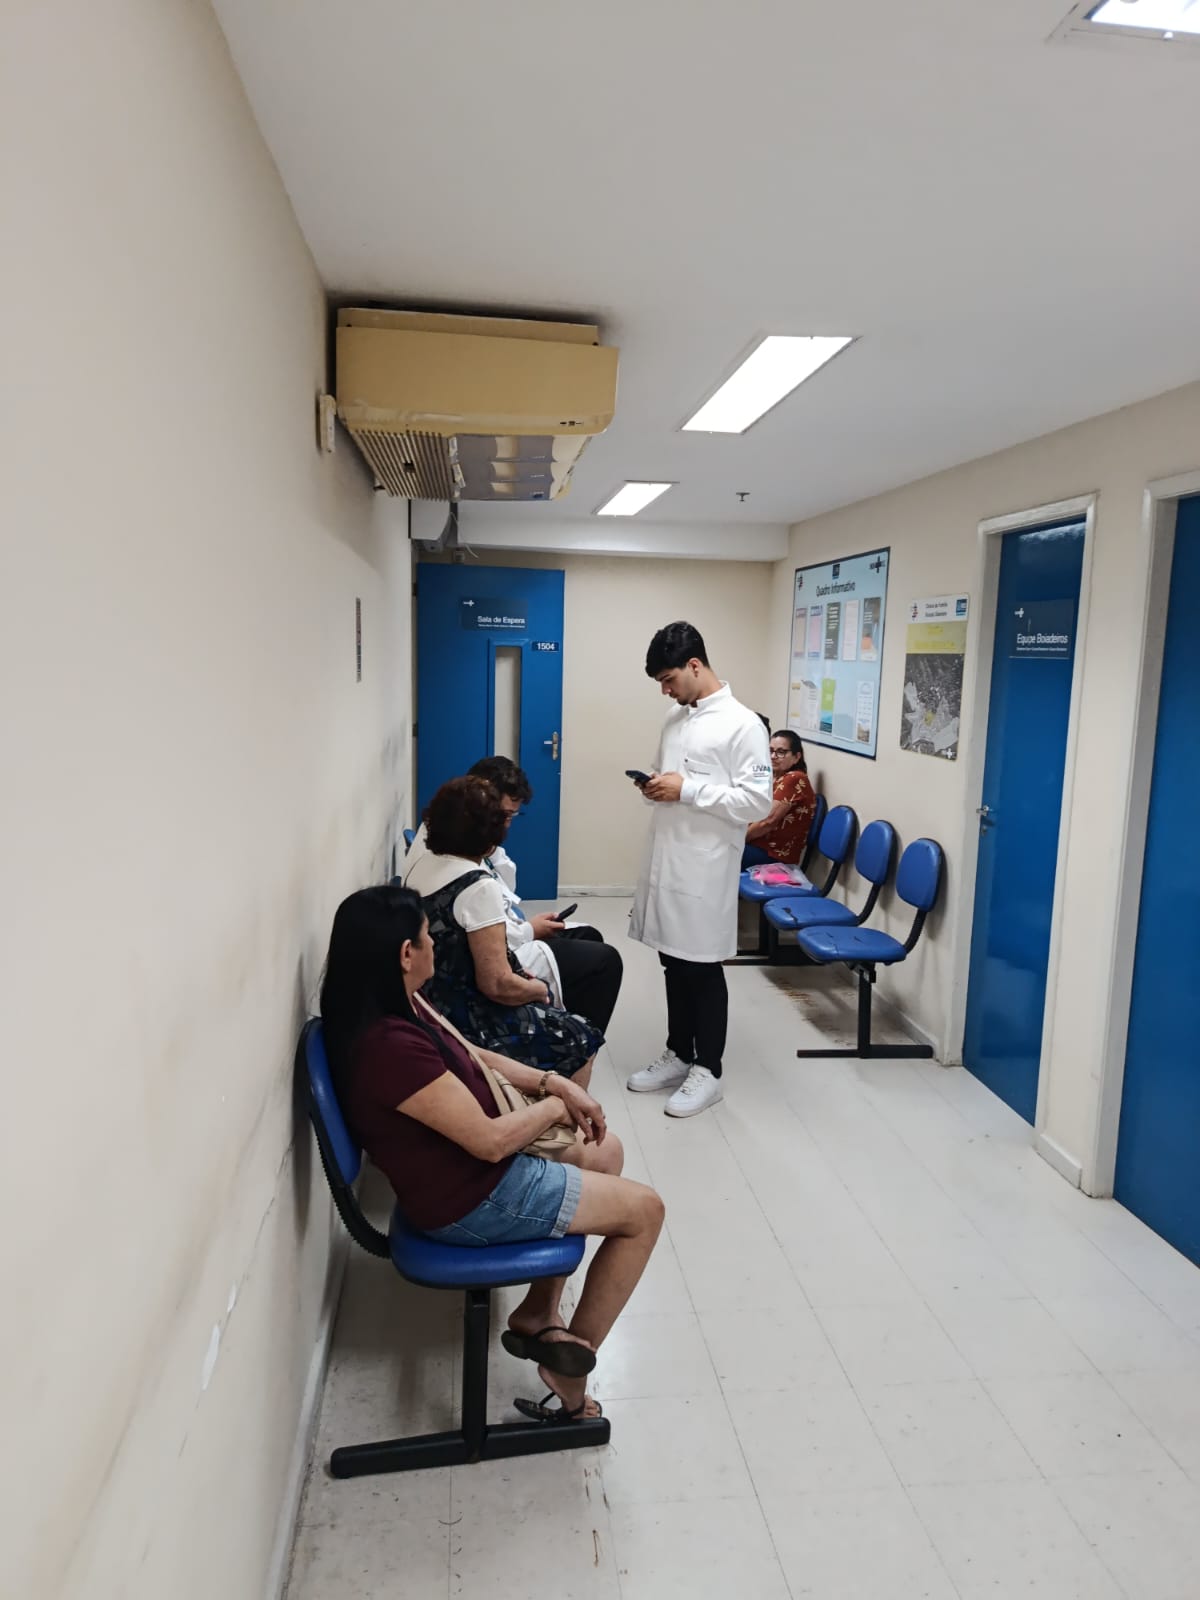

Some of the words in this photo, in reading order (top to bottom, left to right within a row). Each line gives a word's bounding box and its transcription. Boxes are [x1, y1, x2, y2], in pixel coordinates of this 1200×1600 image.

[478, 615, 491, 623] Sala
[503, 616, 525, 624] Espera
[1017, 633, 1035, 645] Equipe
[1037, 633, 1068, 643] Boiadeiros
[537, 642, 555, 650] 1504
